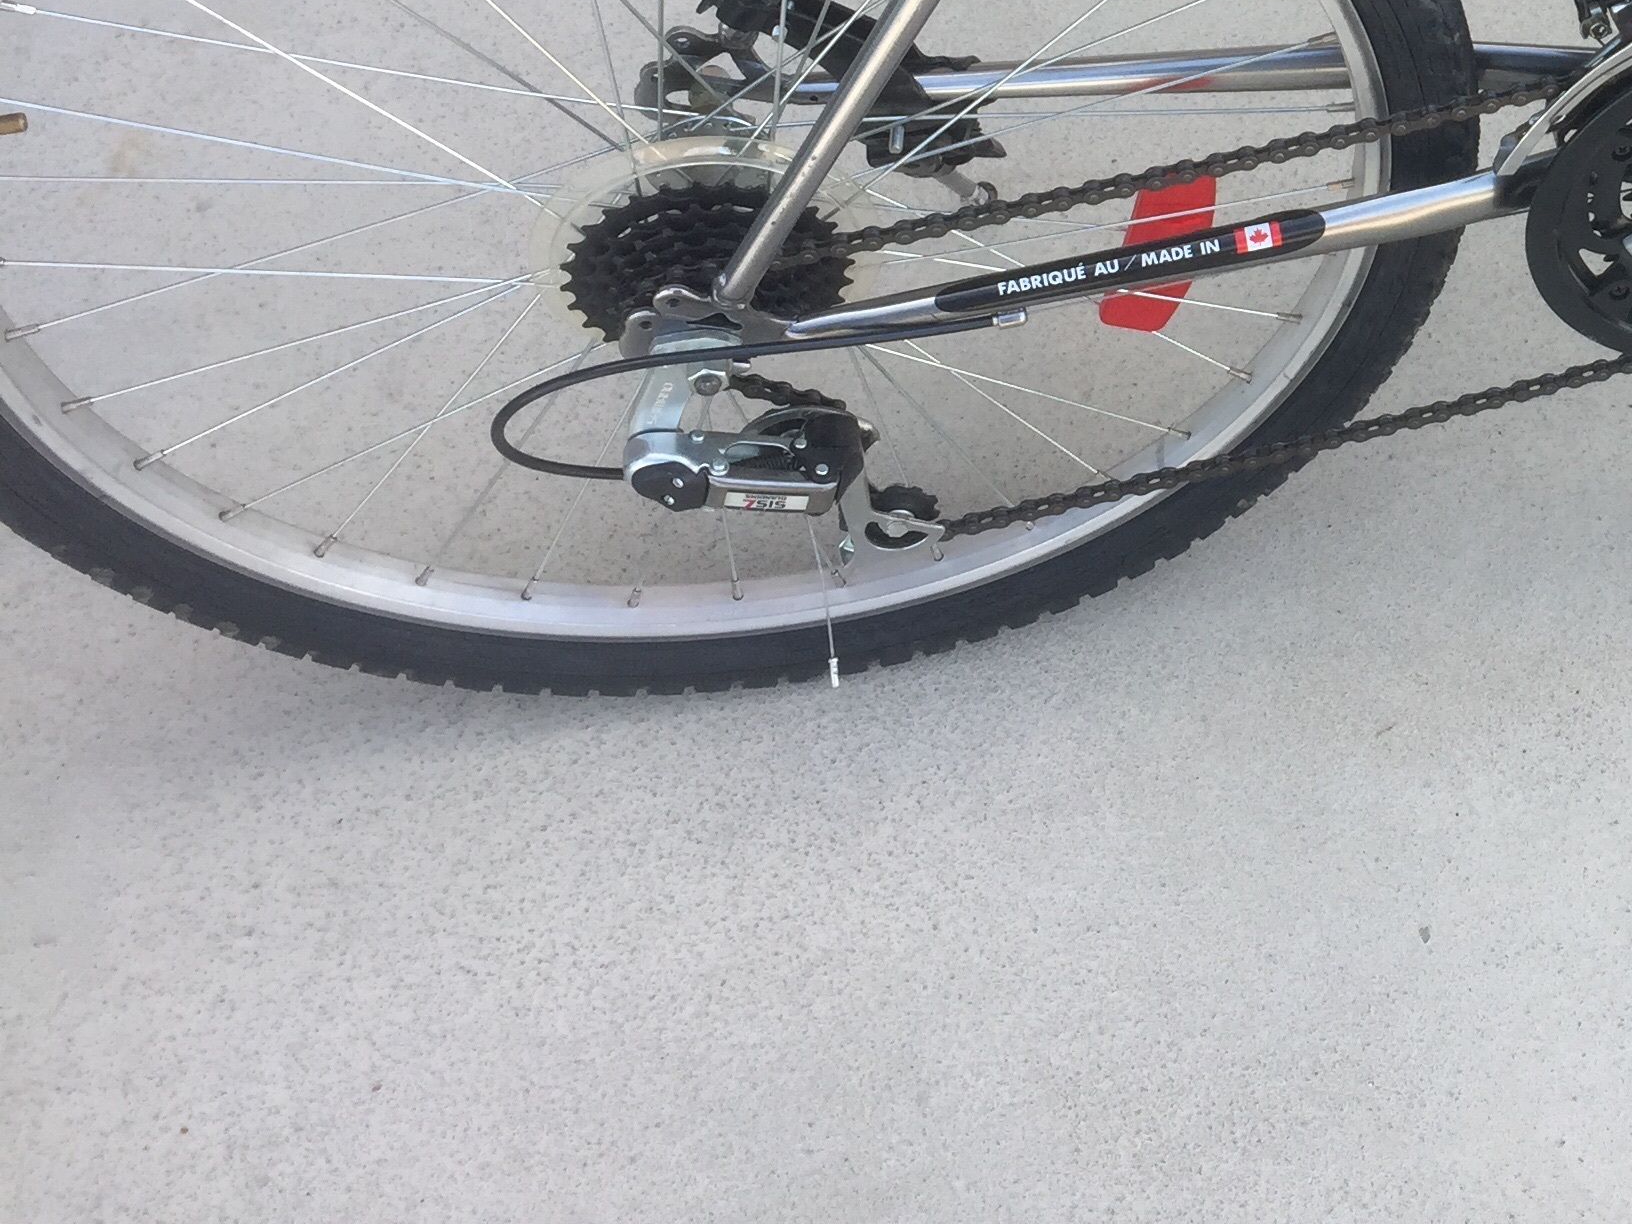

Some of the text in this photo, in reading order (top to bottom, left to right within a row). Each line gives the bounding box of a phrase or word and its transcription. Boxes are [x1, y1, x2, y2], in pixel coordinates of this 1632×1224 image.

[996, 262, 1087, 296] FABRIQUÉ
[1094, 258, 1120, 277] AU
[1140, 244, 1194, 268] MADE
[1199, 238, 1221, 256] IN
